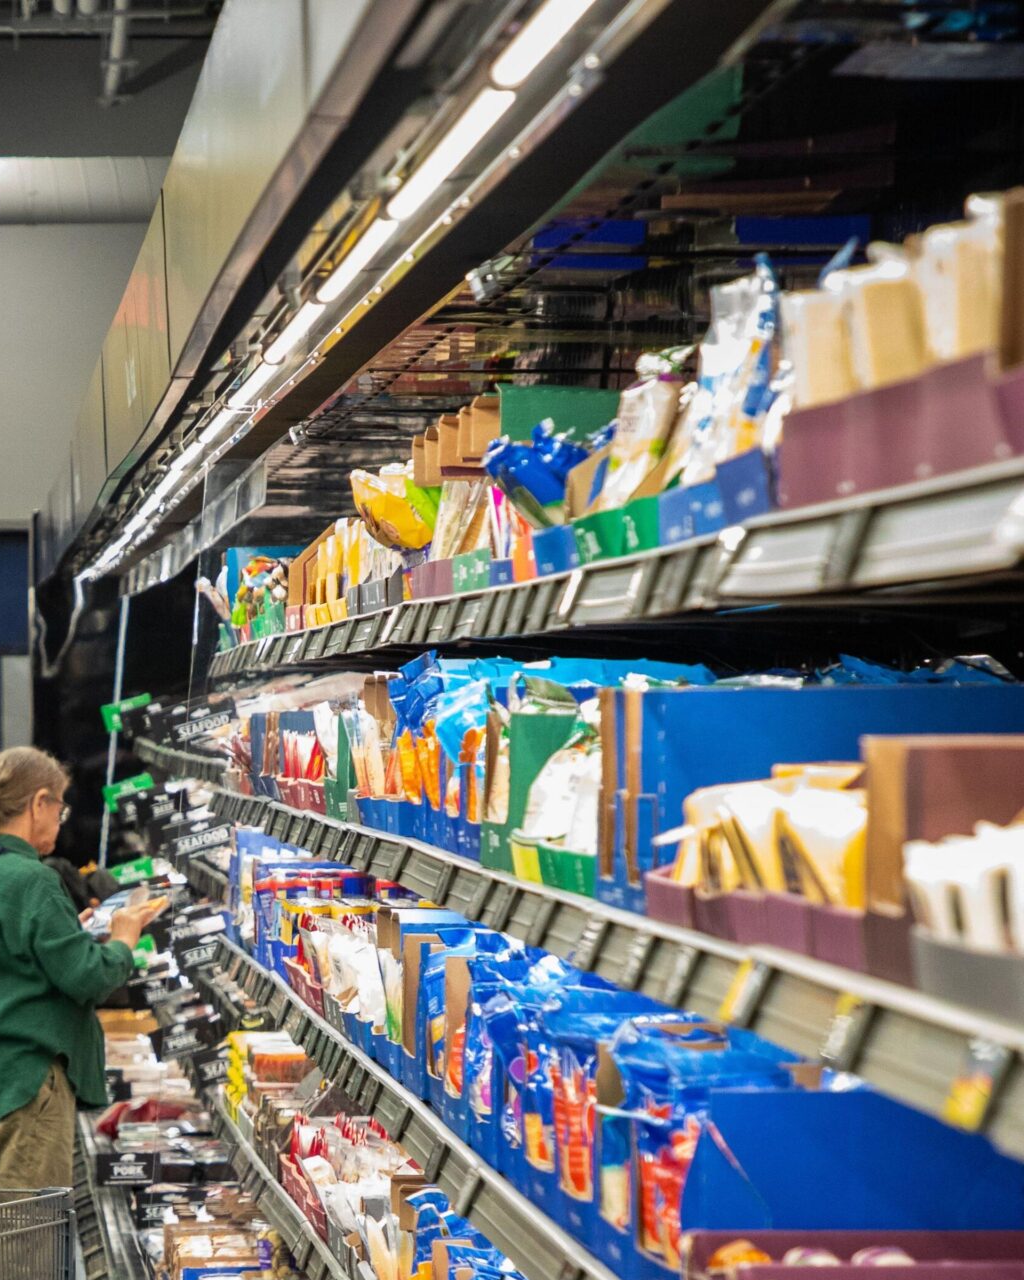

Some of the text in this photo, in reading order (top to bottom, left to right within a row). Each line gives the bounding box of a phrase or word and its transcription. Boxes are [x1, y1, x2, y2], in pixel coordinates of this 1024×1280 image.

[178, 713, 230, 738] SEAFOOD
[177, 826, 229, 852] SEAFOOD
[172, 924, 198, 940] POR
[184, 945, 217, 963] SEAF
[112, 1165, 144, 1177] PORK
